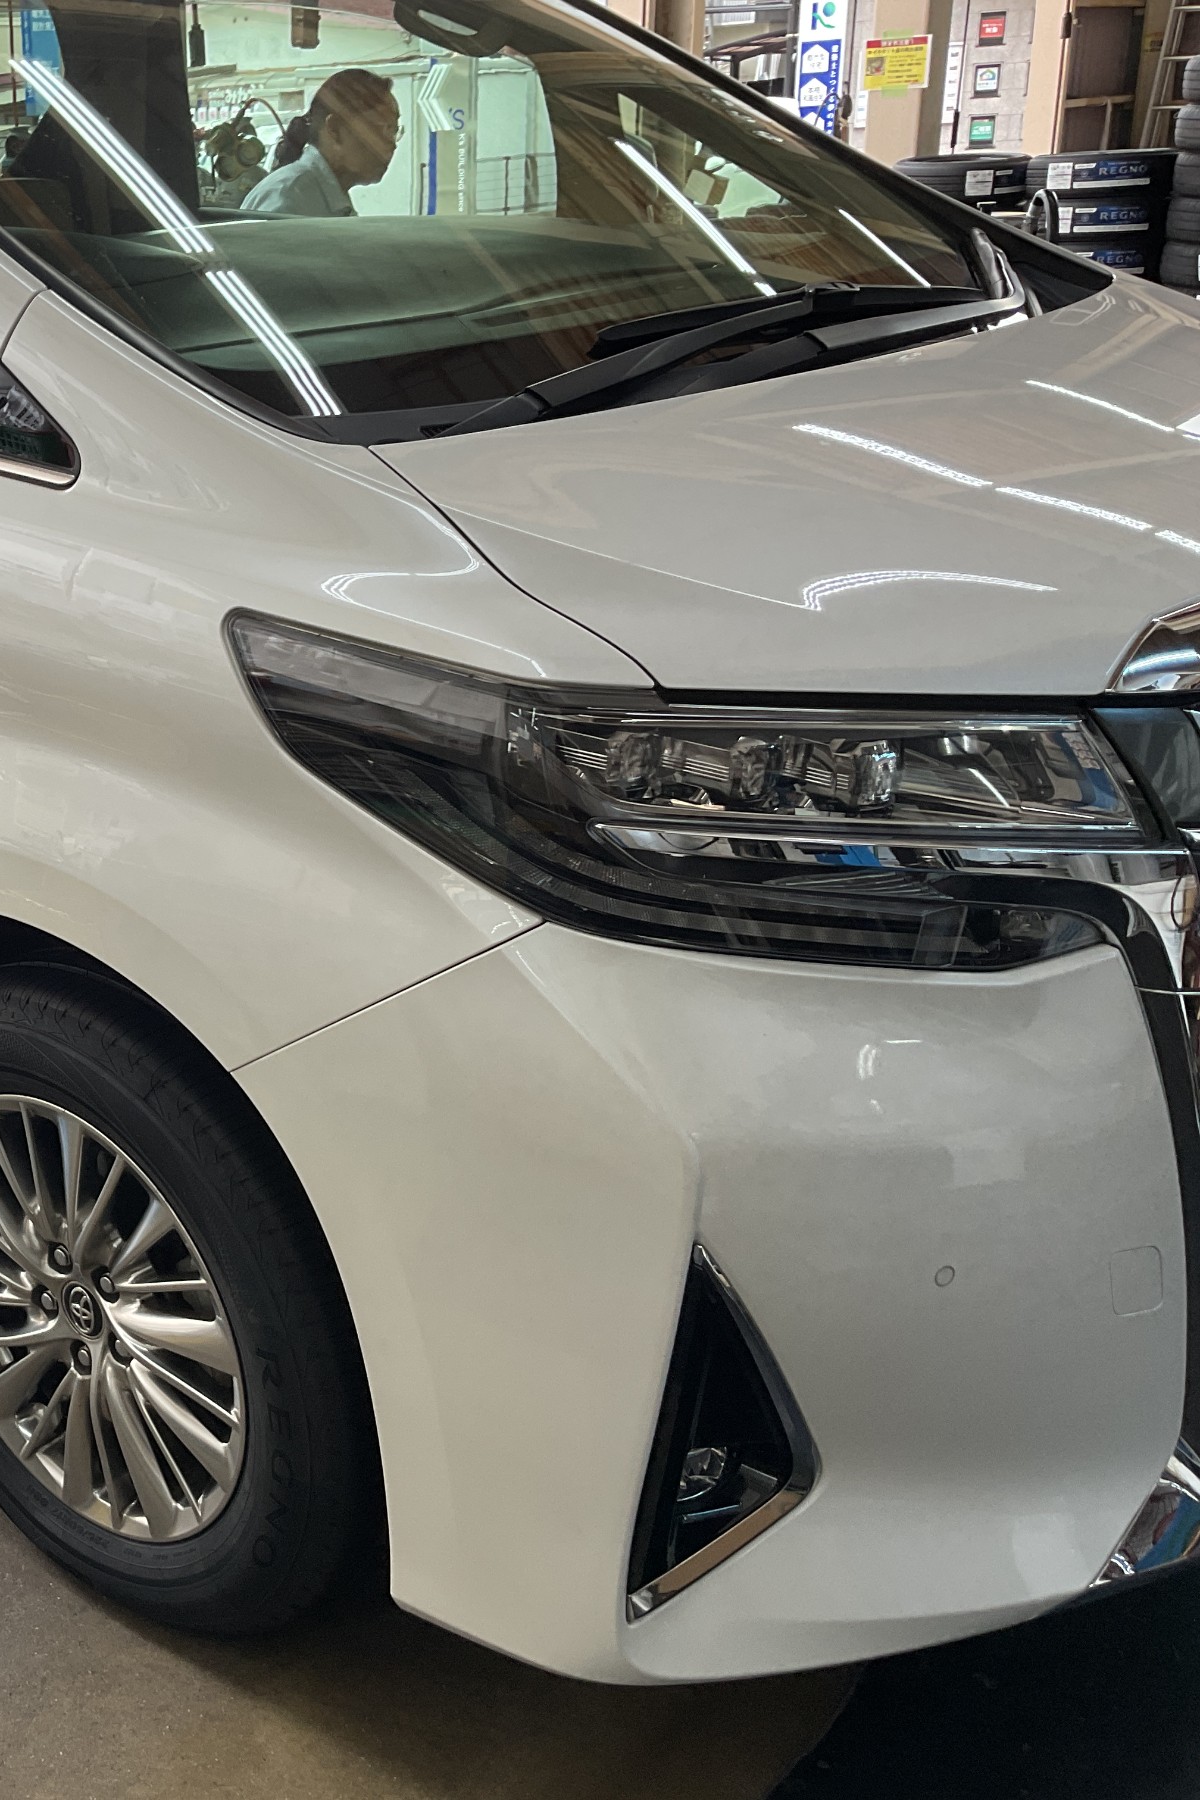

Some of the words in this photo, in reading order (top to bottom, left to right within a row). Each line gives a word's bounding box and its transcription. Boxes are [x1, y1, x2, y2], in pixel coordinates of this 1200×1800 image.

[457, 148, 465, 190] BUILDING
[1099, 164, 1148, 175] REGNO
[254, 1347, 292, 1568] REGNO
